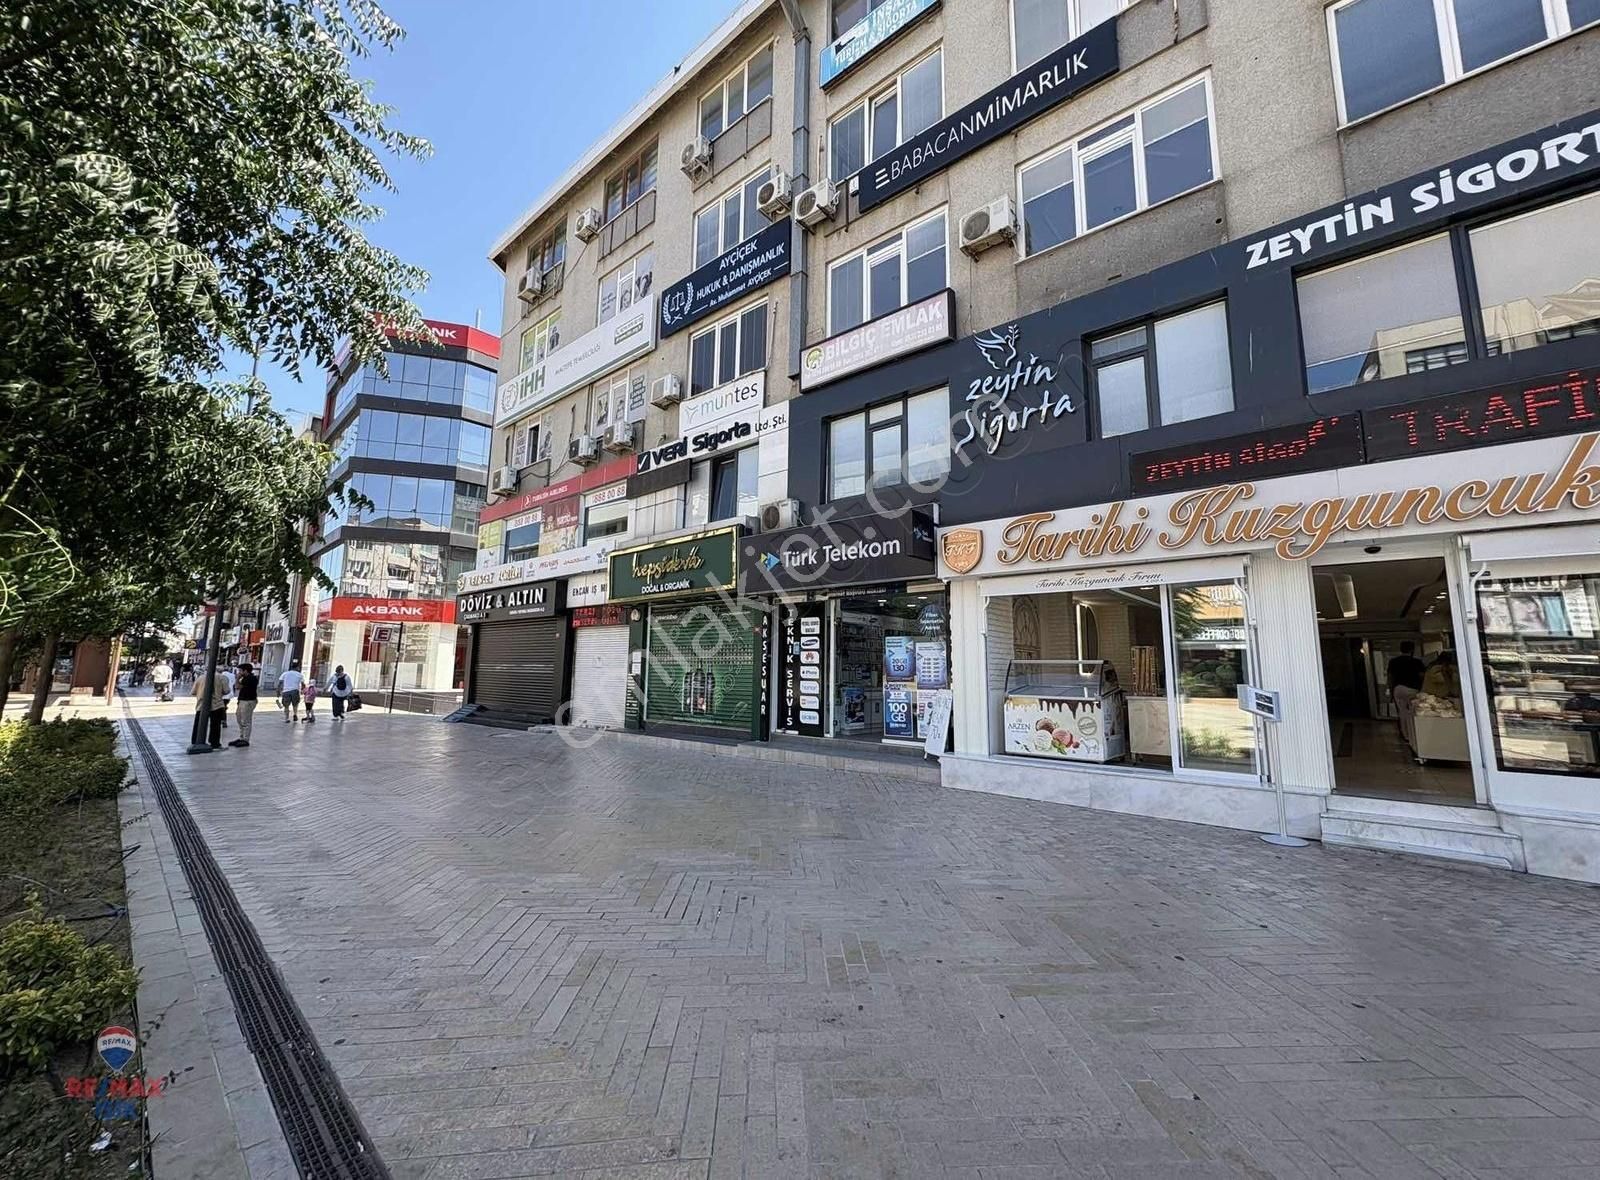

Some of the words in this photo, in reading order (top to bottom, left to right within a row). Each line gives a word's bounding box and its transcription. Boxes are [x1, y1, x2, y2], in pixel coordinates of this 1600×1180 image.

[1246, 196, 1394, 270] ZEYTİN
[696, 279, 721, 301] HUKUK
[722, 275, 729, 287] &
[729, 242, 785, 282] DANIŞMANLIK
[719, 239, 758, 271] AYÇİÇEK
[825, 328, 876, 361] BİLGİÇ
[881, 300, 944, 337] EMLAK
[701, 383, 758, 416] muntes
[1391, 370, 1600, 446] TRAFİ
[955, 390, 1076, 454] Sigorta
[652, 436, 688, 466] VERİ
[692, 421, 751, 453] Sigorta
[996, 501, 1150, 565] Tarihi
[1159, 432, 1600, 562] Kuzguncuk
[783, 551, 817, 568] Türk
[823, 539, 900, 563] Telekom
[641, 582, 659, 594] DOĞAL
[1036, 578, 1065, 588] Tarihi
[1066, 573, 1125, 588] Kuzguncuk
[353, 605, 423, 616] AKBANK
[460, 593, 492, 613] DÖVİZ
[495, 594, 503, 608] &
[508, 588, 544, 607] ALTIN
[786, 609, 795, 664] TEKNİK
[760, 615, 769, 715] AKSESUAR
[786, 670, 794, 726] SERVİS
[888, 703, 908, 713] 100
[891, 713, 906, 722] GB
[1007, 722, 1031, 730] ARZEN
